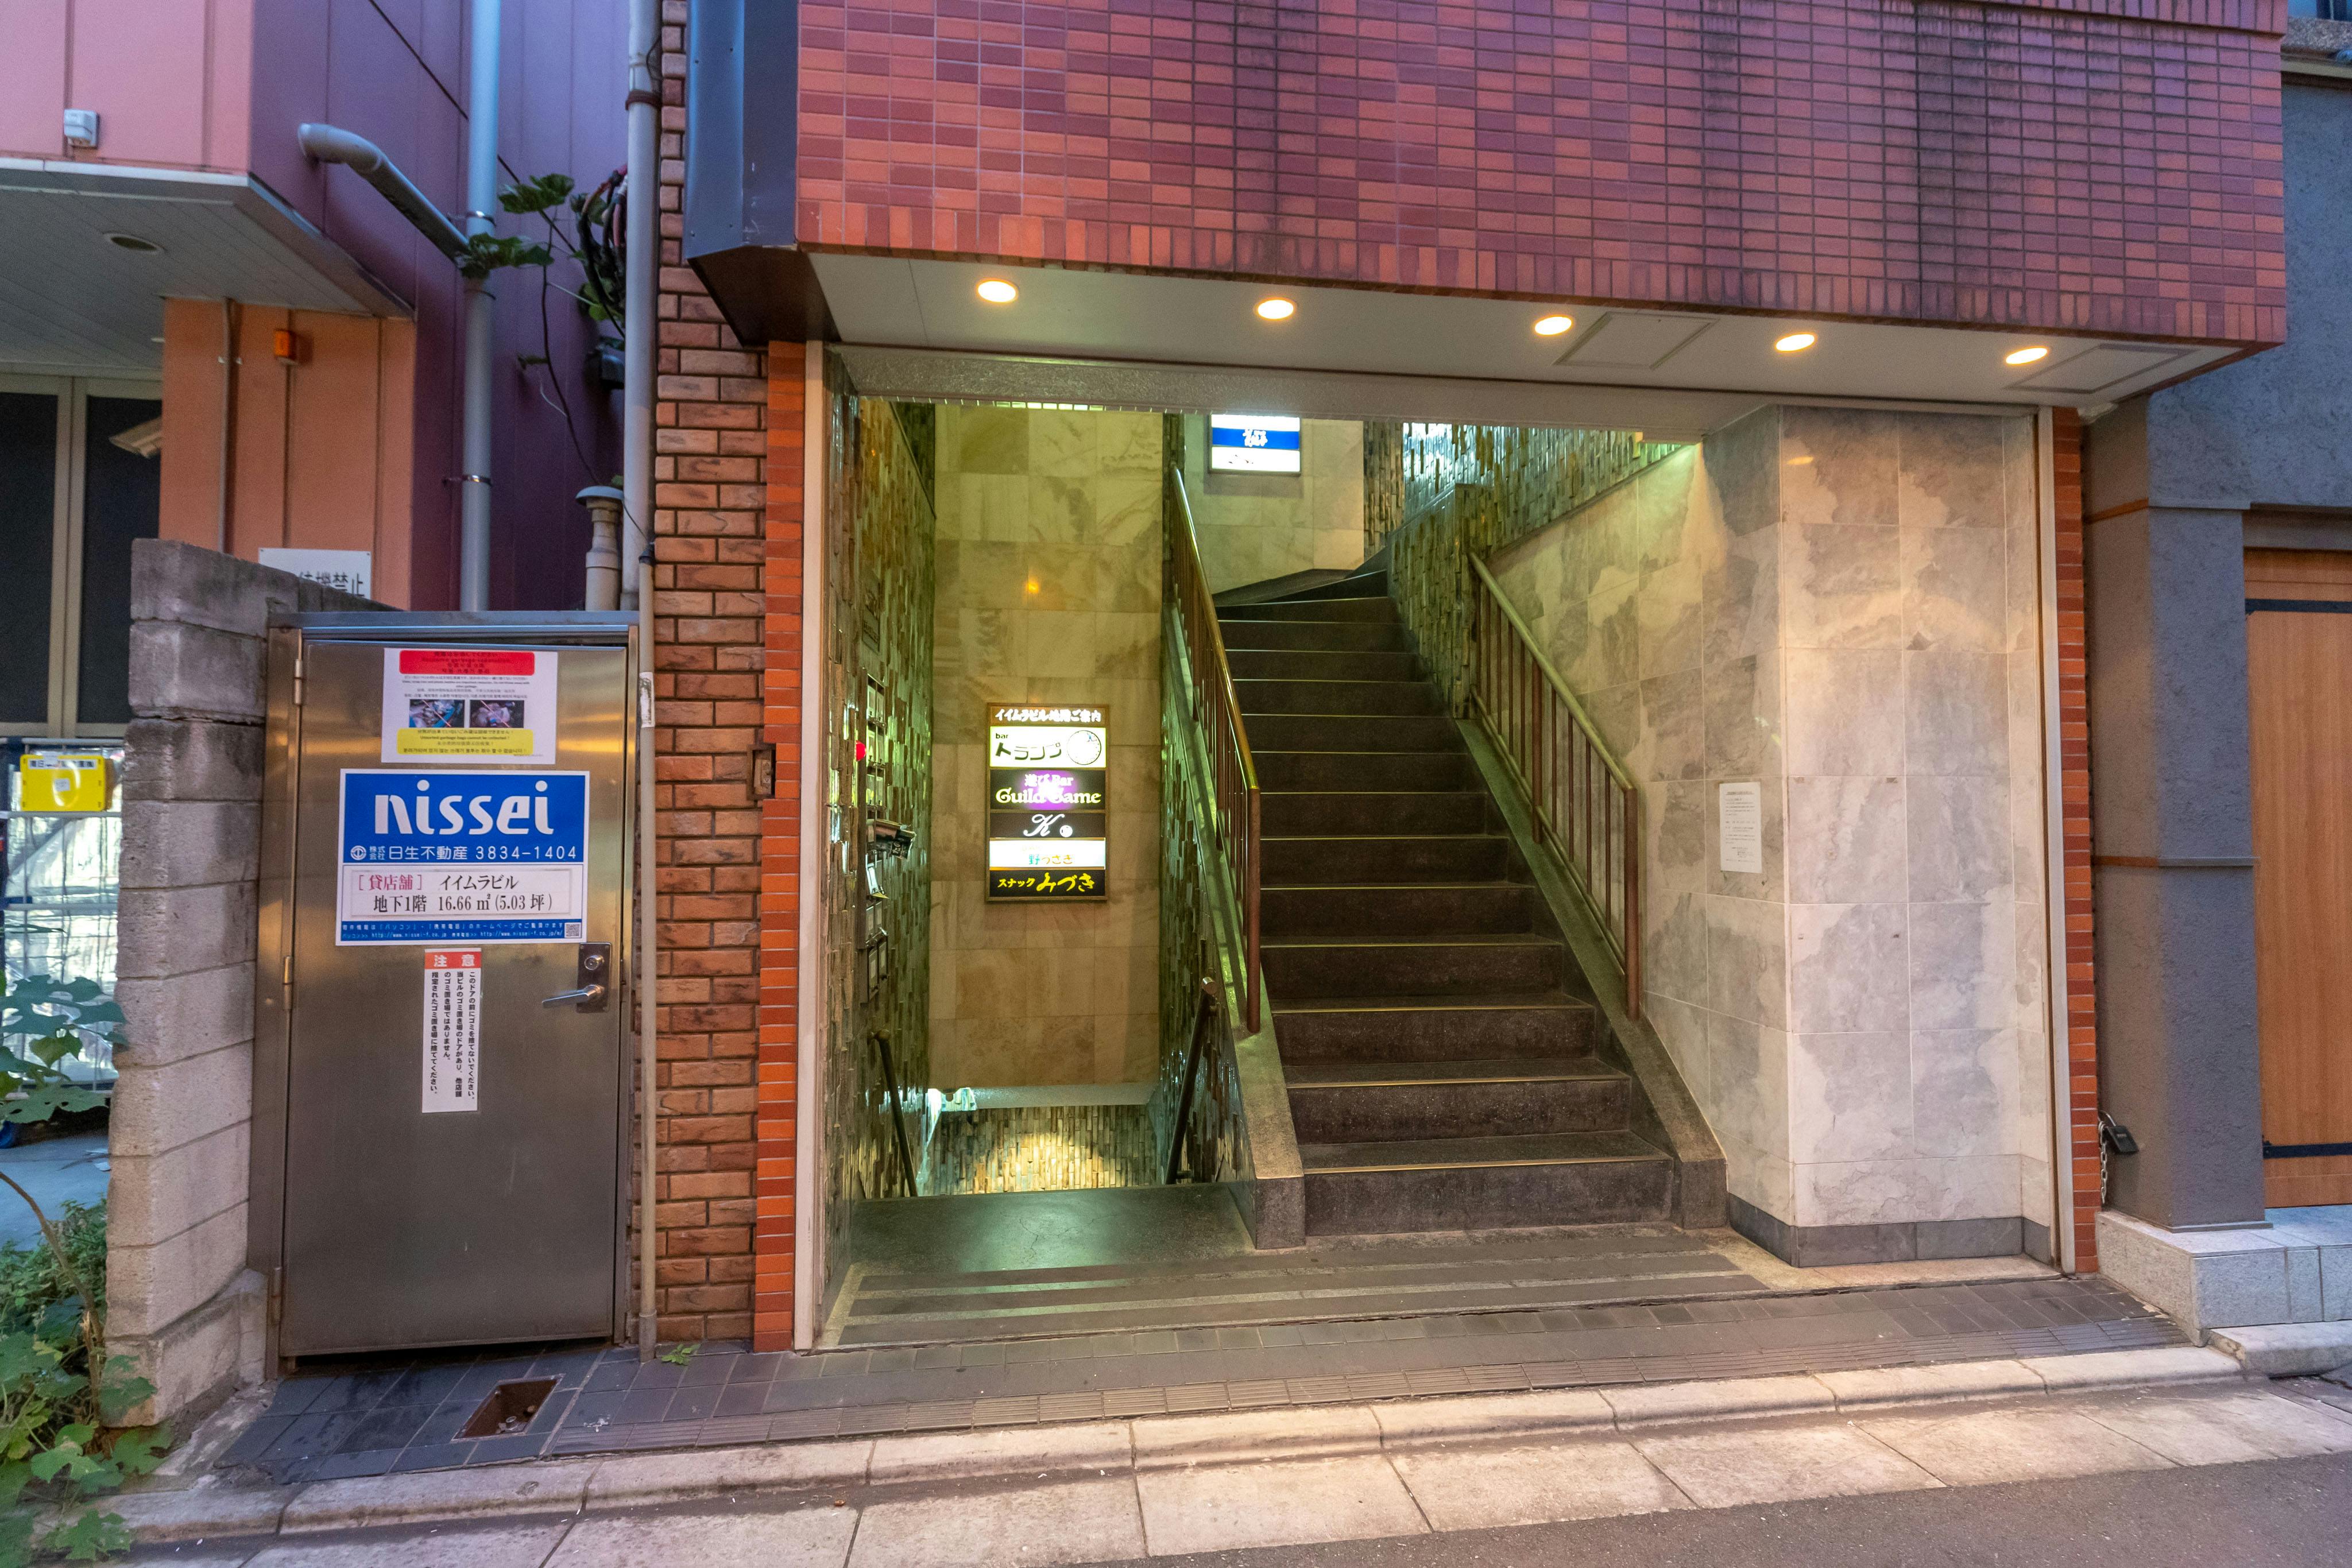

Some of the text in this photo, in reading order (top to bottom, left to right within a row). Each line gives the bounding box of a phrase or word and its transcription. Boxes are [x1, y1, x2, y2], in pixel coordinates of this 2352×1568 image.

[995, 742, 1061, 761] トランプ
[996, 787, 1102, 804] Guild Game
[375, 779, 555, 835] nissei
[369, 845, 576, 860] 株式会社 日生不動産 3834-1404
[440, 874, 519, 891] イイムラビル
[997, 872, 1095, 893] スナック みづき
[373, 895, 427, 913] 地下1階
[439, 895, 471, 911] 16.66
[434, 954, 475, 967] 注意
